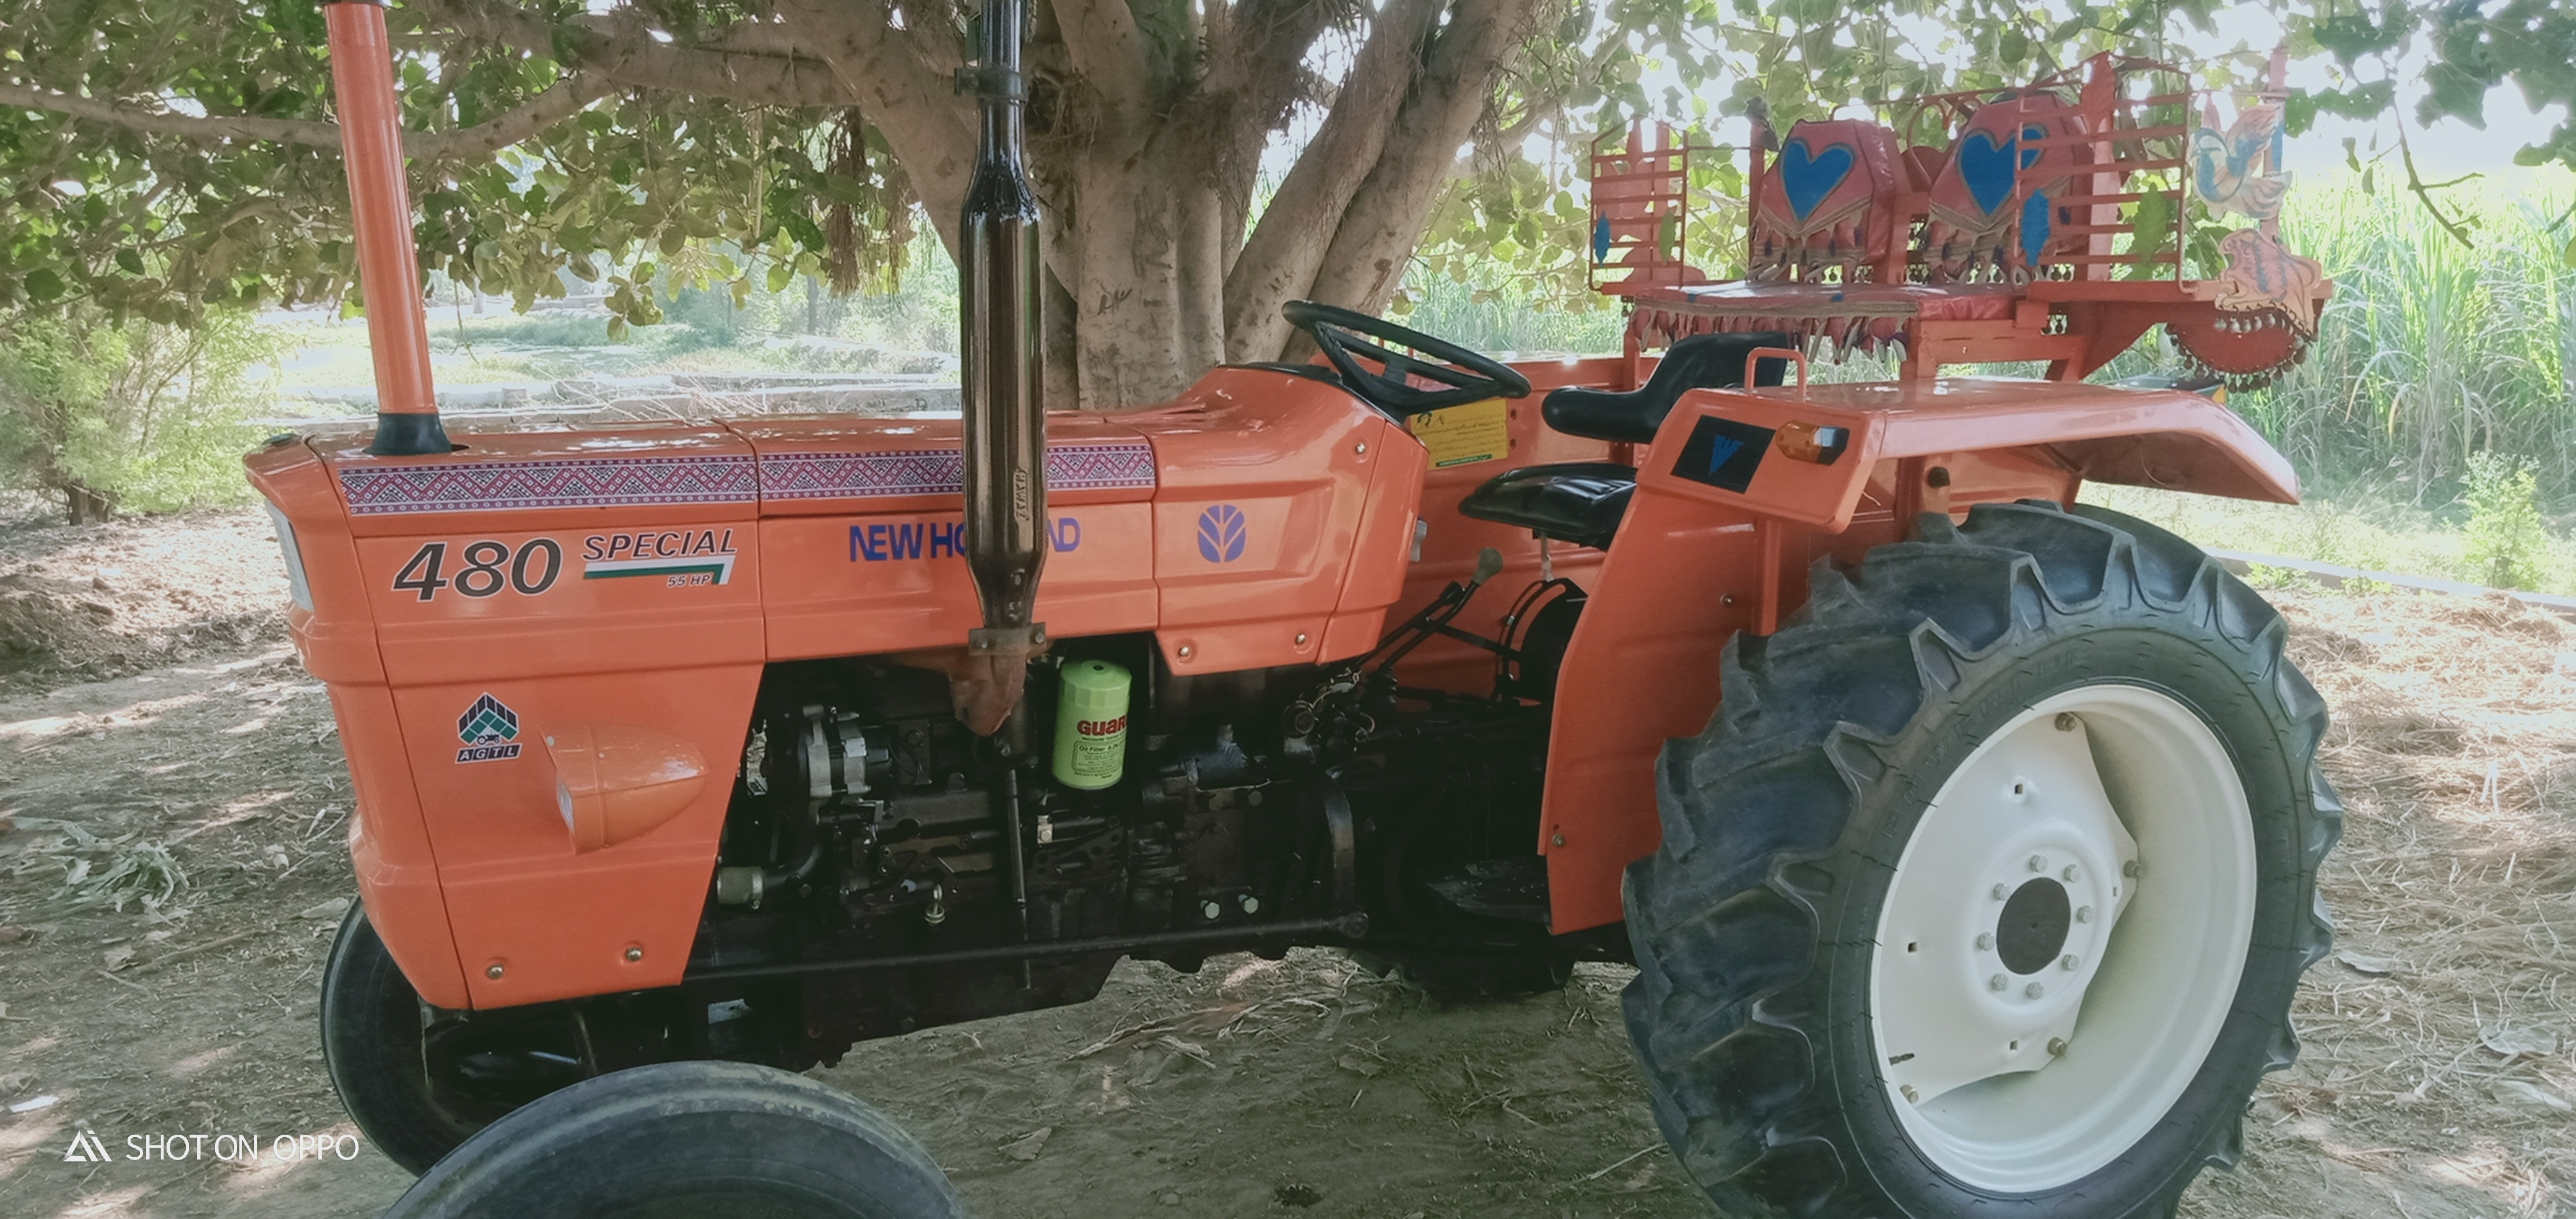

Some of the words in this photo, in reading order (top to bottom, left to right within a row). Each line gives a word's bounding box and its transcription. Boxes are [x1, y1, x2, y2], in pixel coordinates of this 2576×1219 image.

[581, 529, 738, 561] SPECIAL
[850, 523, 924, 562] NEW
[391, 537, 563, 602] 480
[666, 575, 686, 588] 55
[690, 574, 711, 585] HP
[459, 746, 515, 761] AGTL
